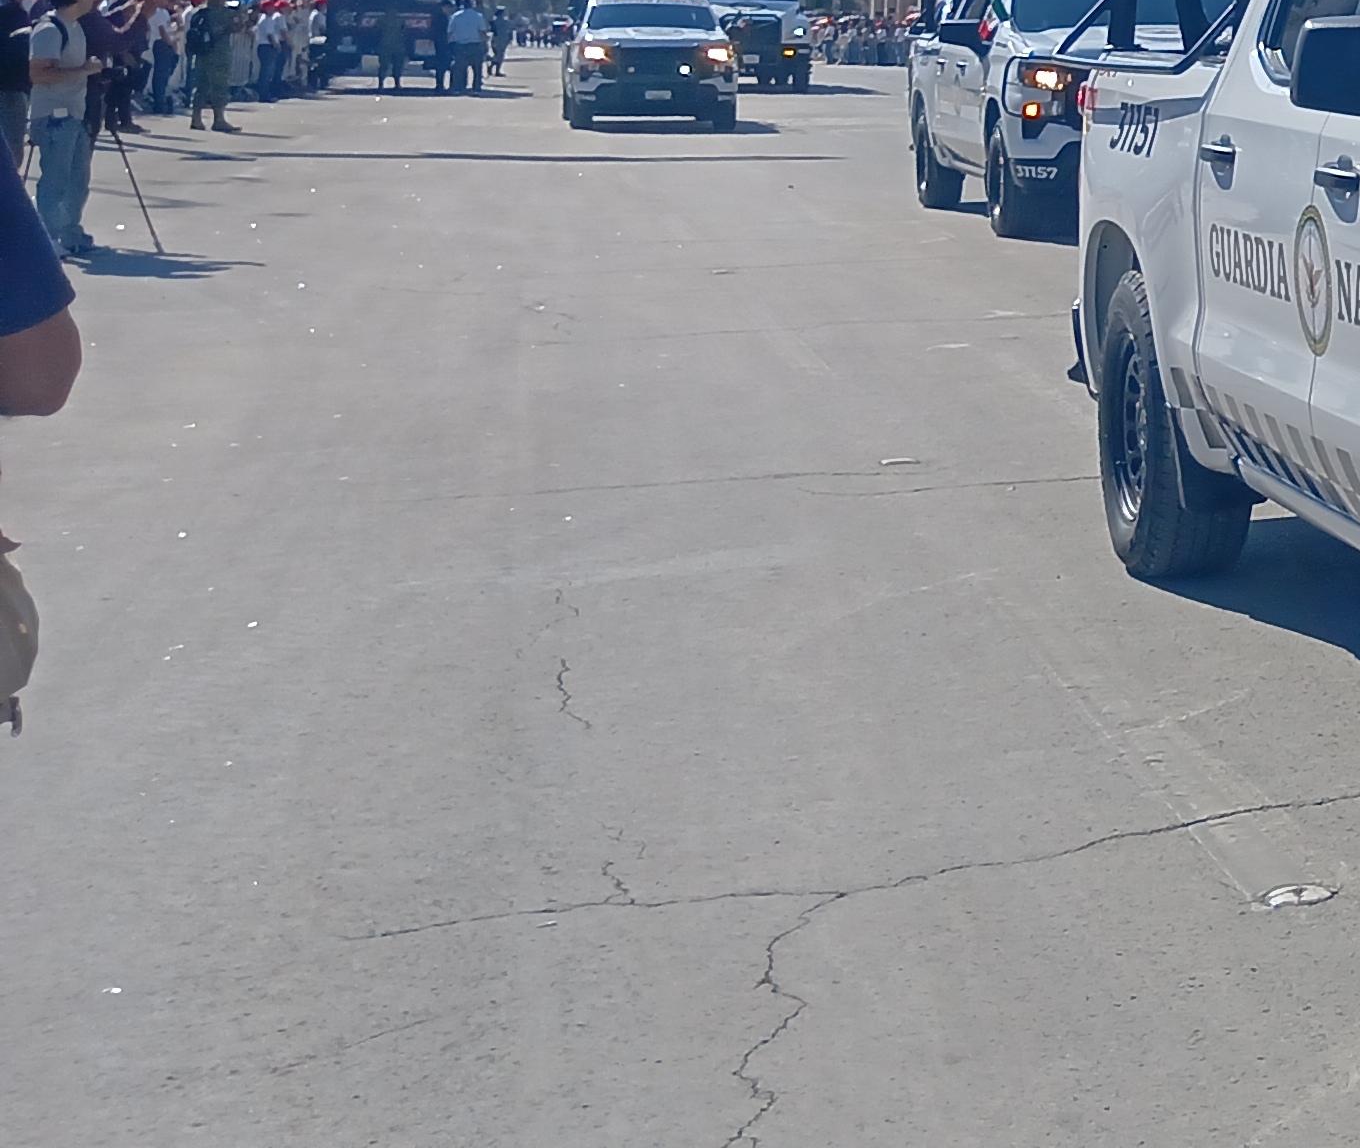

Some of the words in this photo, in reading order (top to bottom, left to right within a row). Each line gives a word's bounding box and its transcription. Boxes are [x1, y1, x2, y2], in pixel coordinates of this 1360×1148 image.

[1109, 102, 1160, 158] 31151
[1015, 165, 1059, 180] 31157
[1208, 223, 1292, 303] GUARDIA
